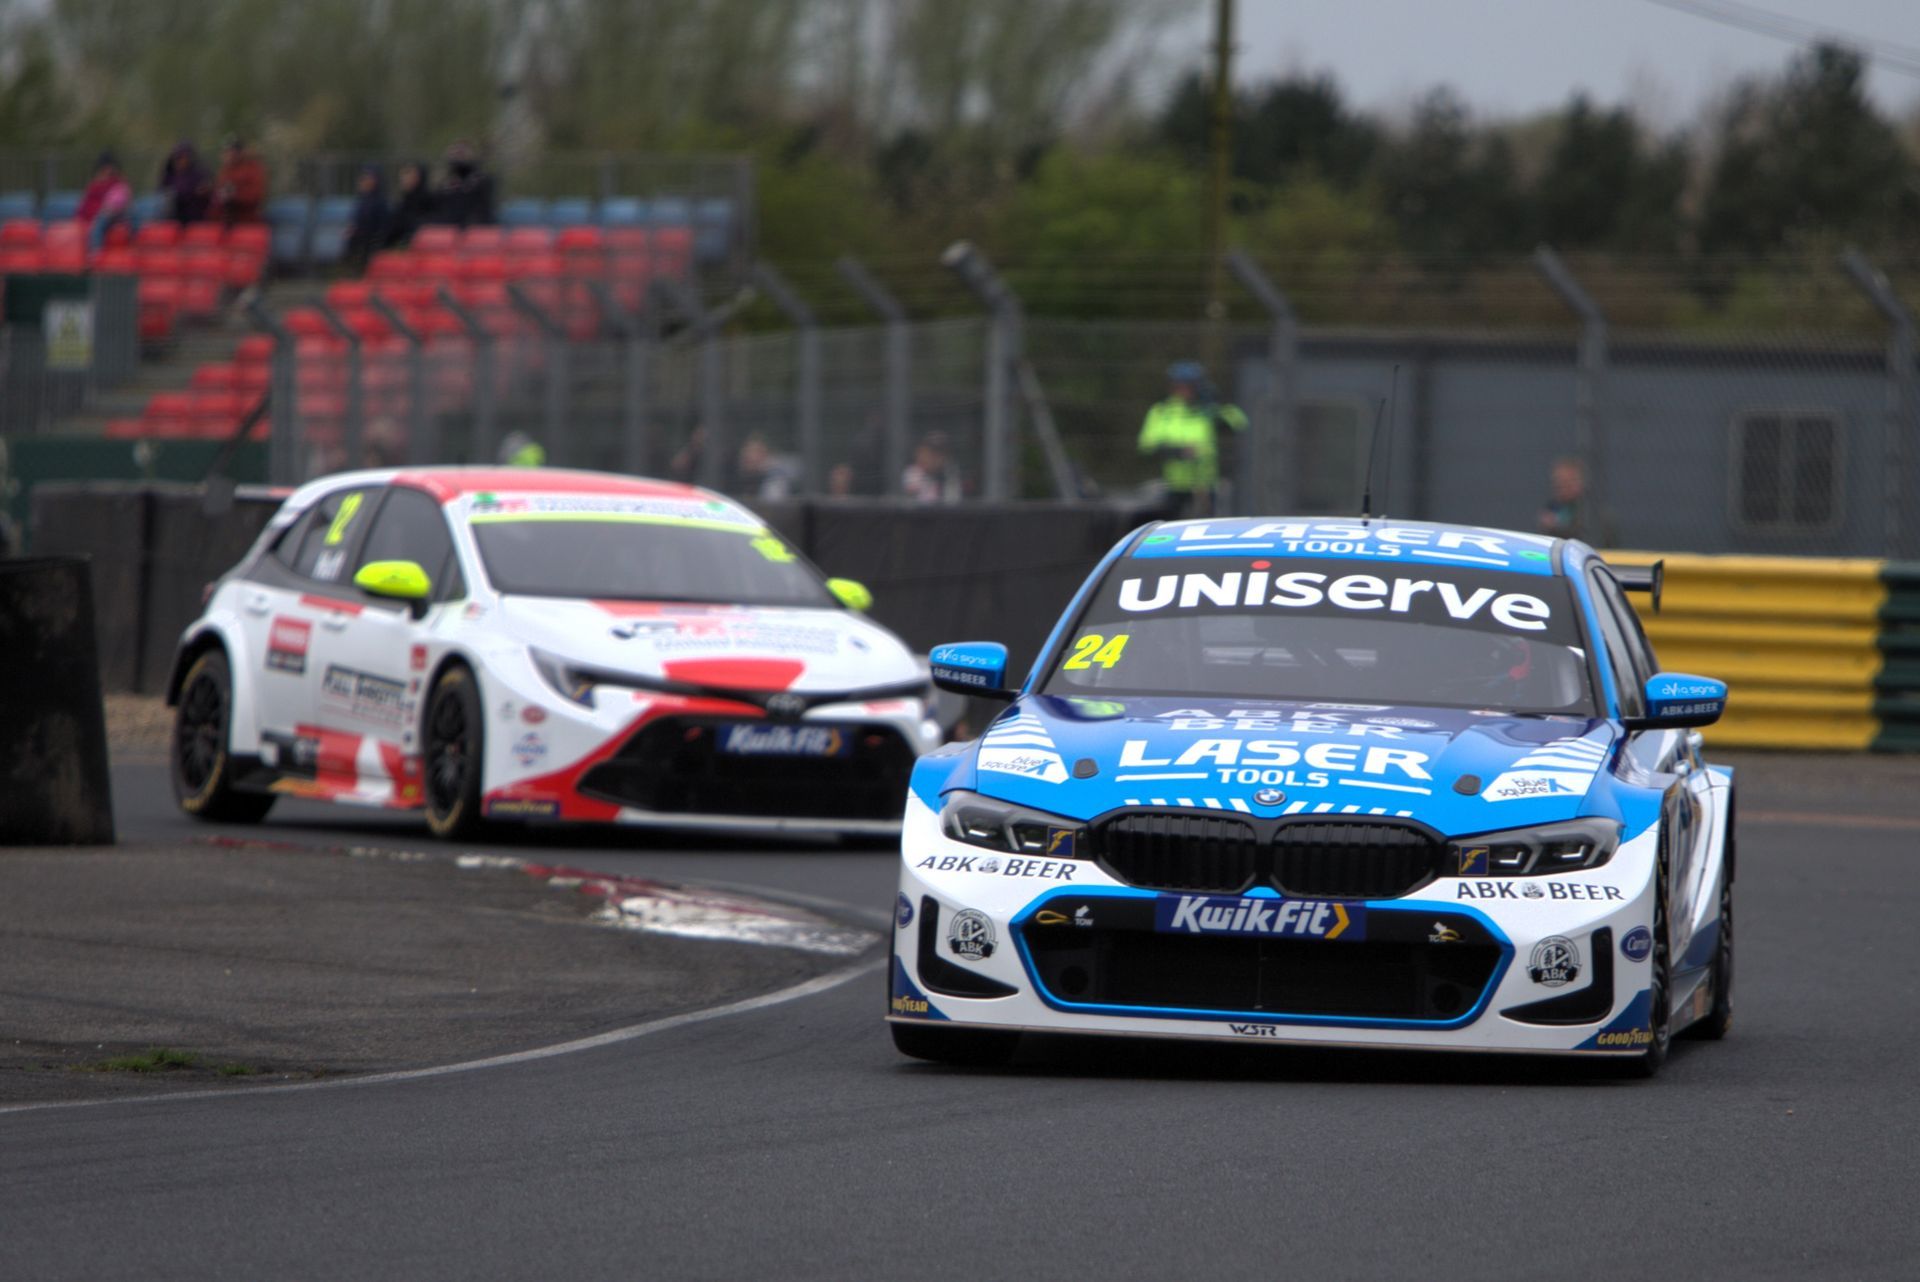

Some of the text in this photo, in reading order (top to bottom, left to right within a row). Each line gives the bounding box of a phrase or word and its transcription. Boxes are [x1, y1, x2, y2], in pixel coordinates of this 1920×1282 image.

[1177, 522, 1510, 556] LASER
[1283, 540, 1400, 556] TOOLS
[1063, 634, 1129, 670] 24
[960, 672, 987, 686] BEER
[1155, 708, 1352, 721] ABK
[1660, 702, 1719, 716] ABK BEER
[1168, 717, 1407, 740] BEER
[982, 761, 1028, 773] square
[1118, 739, 1433, 781] LASER
[1216, 768, 1329, 788] TOOLS
[1514, 778, 1547, 788] blue
[1497, 785, 1549, 797] square
[917, 856, 1077, 880] ABK BEER
[1456, 882, 1627, 900] ABK BEER
[1075, 918, 1094, 926] TOW
[959, 941, 984, 956] ABK
[1540, 968, 1569, 981] ABK
[1229, 1023, 1277, 1037] WSR
